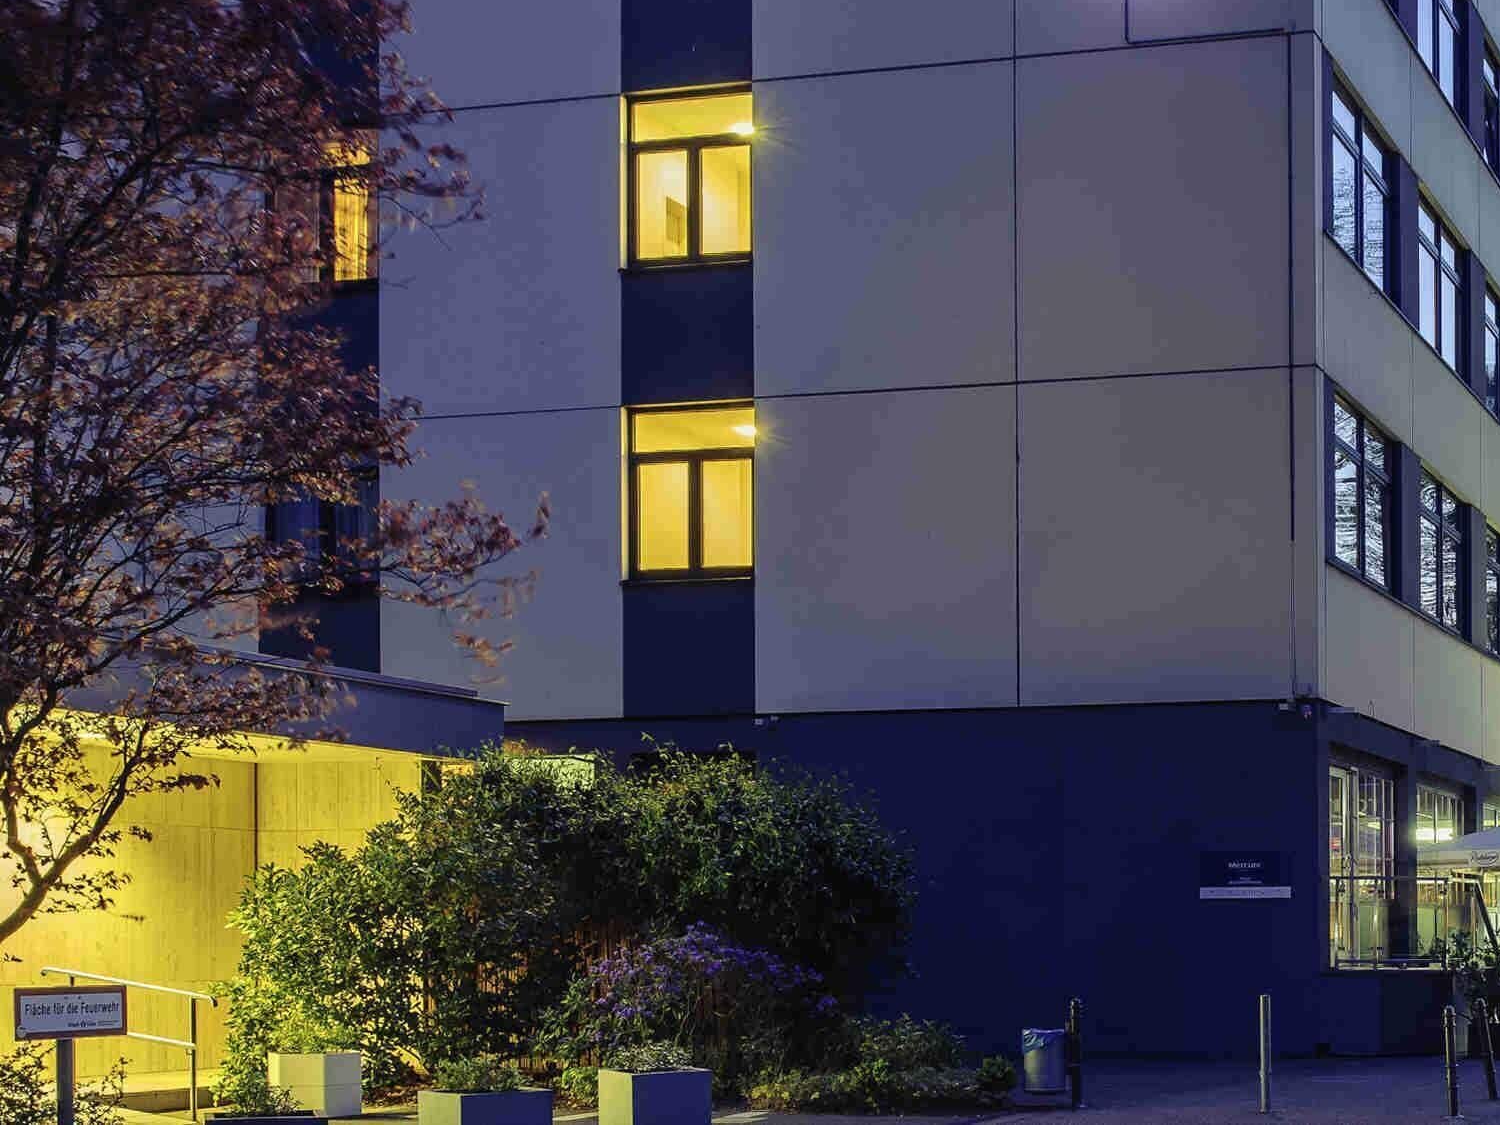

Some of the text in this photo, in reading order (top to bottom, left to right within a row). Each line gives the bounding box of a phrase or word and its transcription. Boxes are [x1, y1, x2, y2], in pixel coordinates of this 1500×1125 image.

[24, 1000, 119, 1016] Fläche für die Feuerwehr
